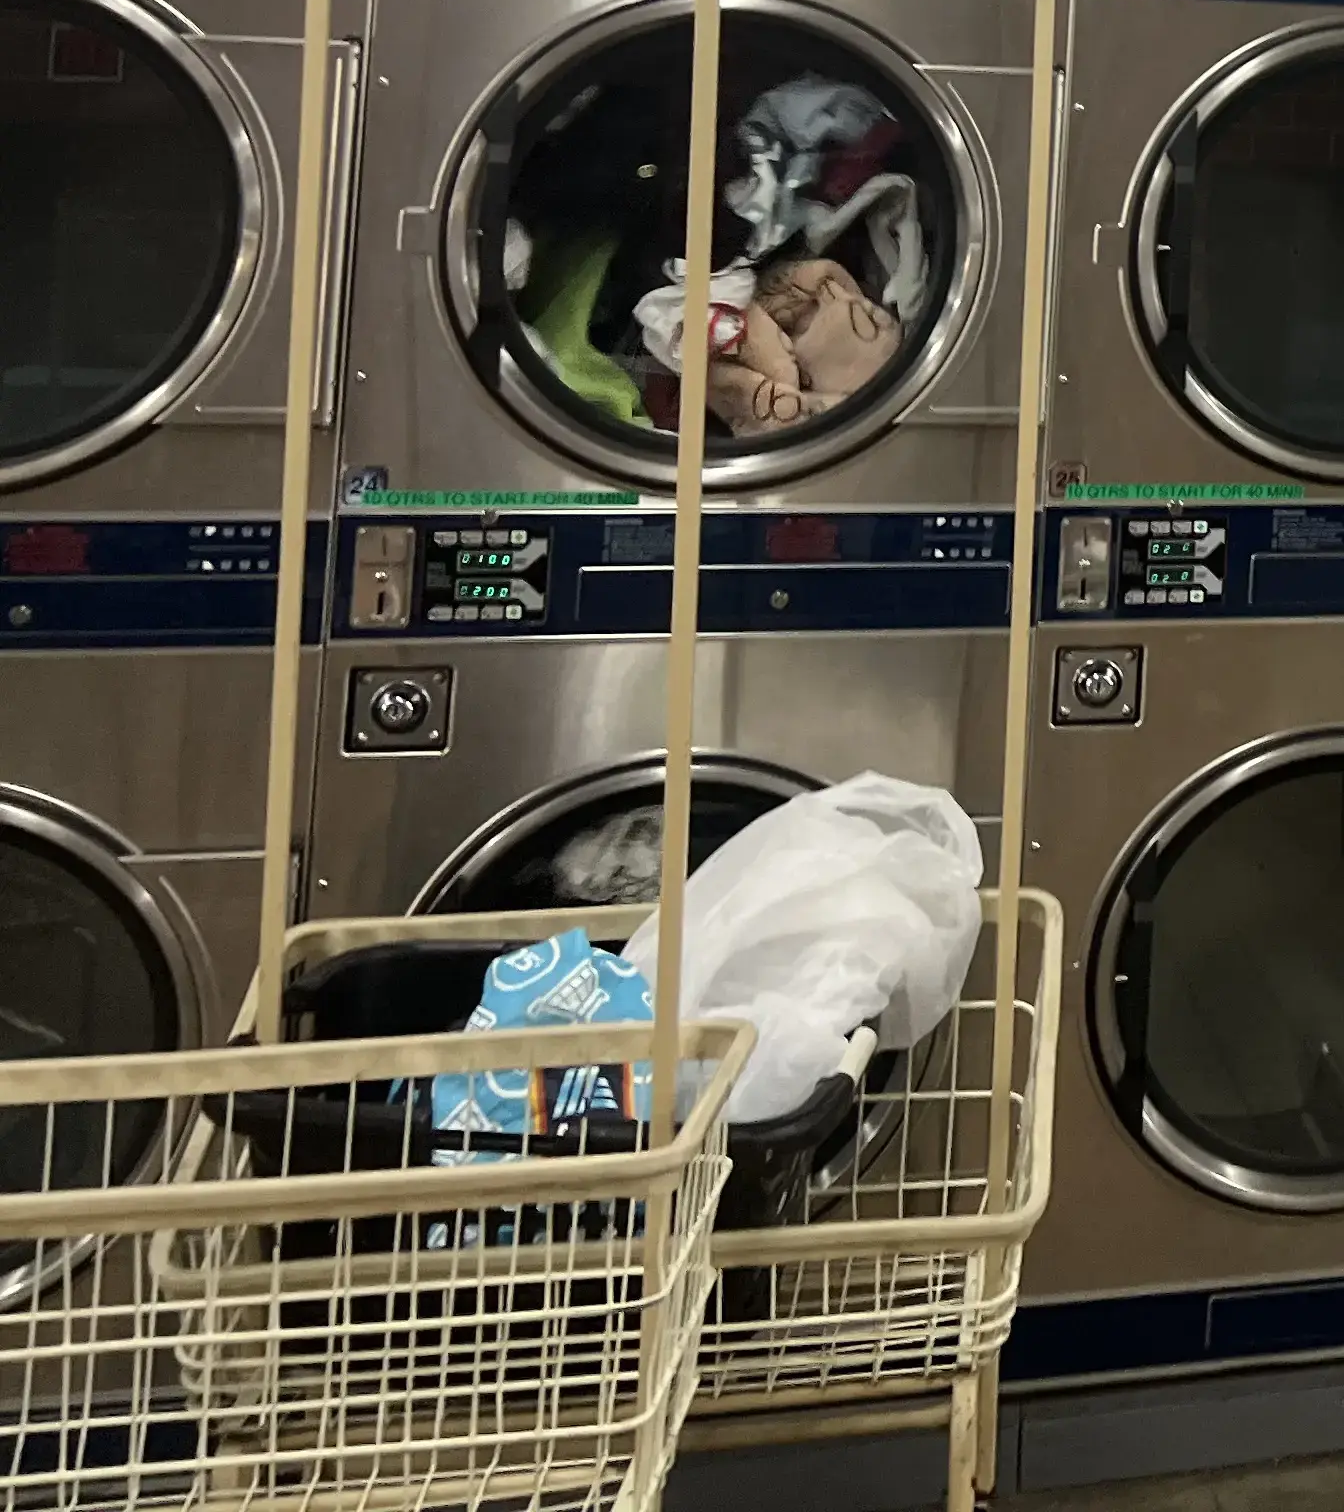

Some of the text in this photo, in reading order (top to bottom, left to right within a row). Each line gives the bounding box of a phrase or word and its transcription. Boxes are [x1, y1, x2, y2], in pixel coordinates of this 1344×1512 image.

[350, 476, 378, 493] 24
[1135, 485, 1155, 498] TO
[1158, 485, 1206, 498] START
[1211, 485, 1243, 498] FOR
